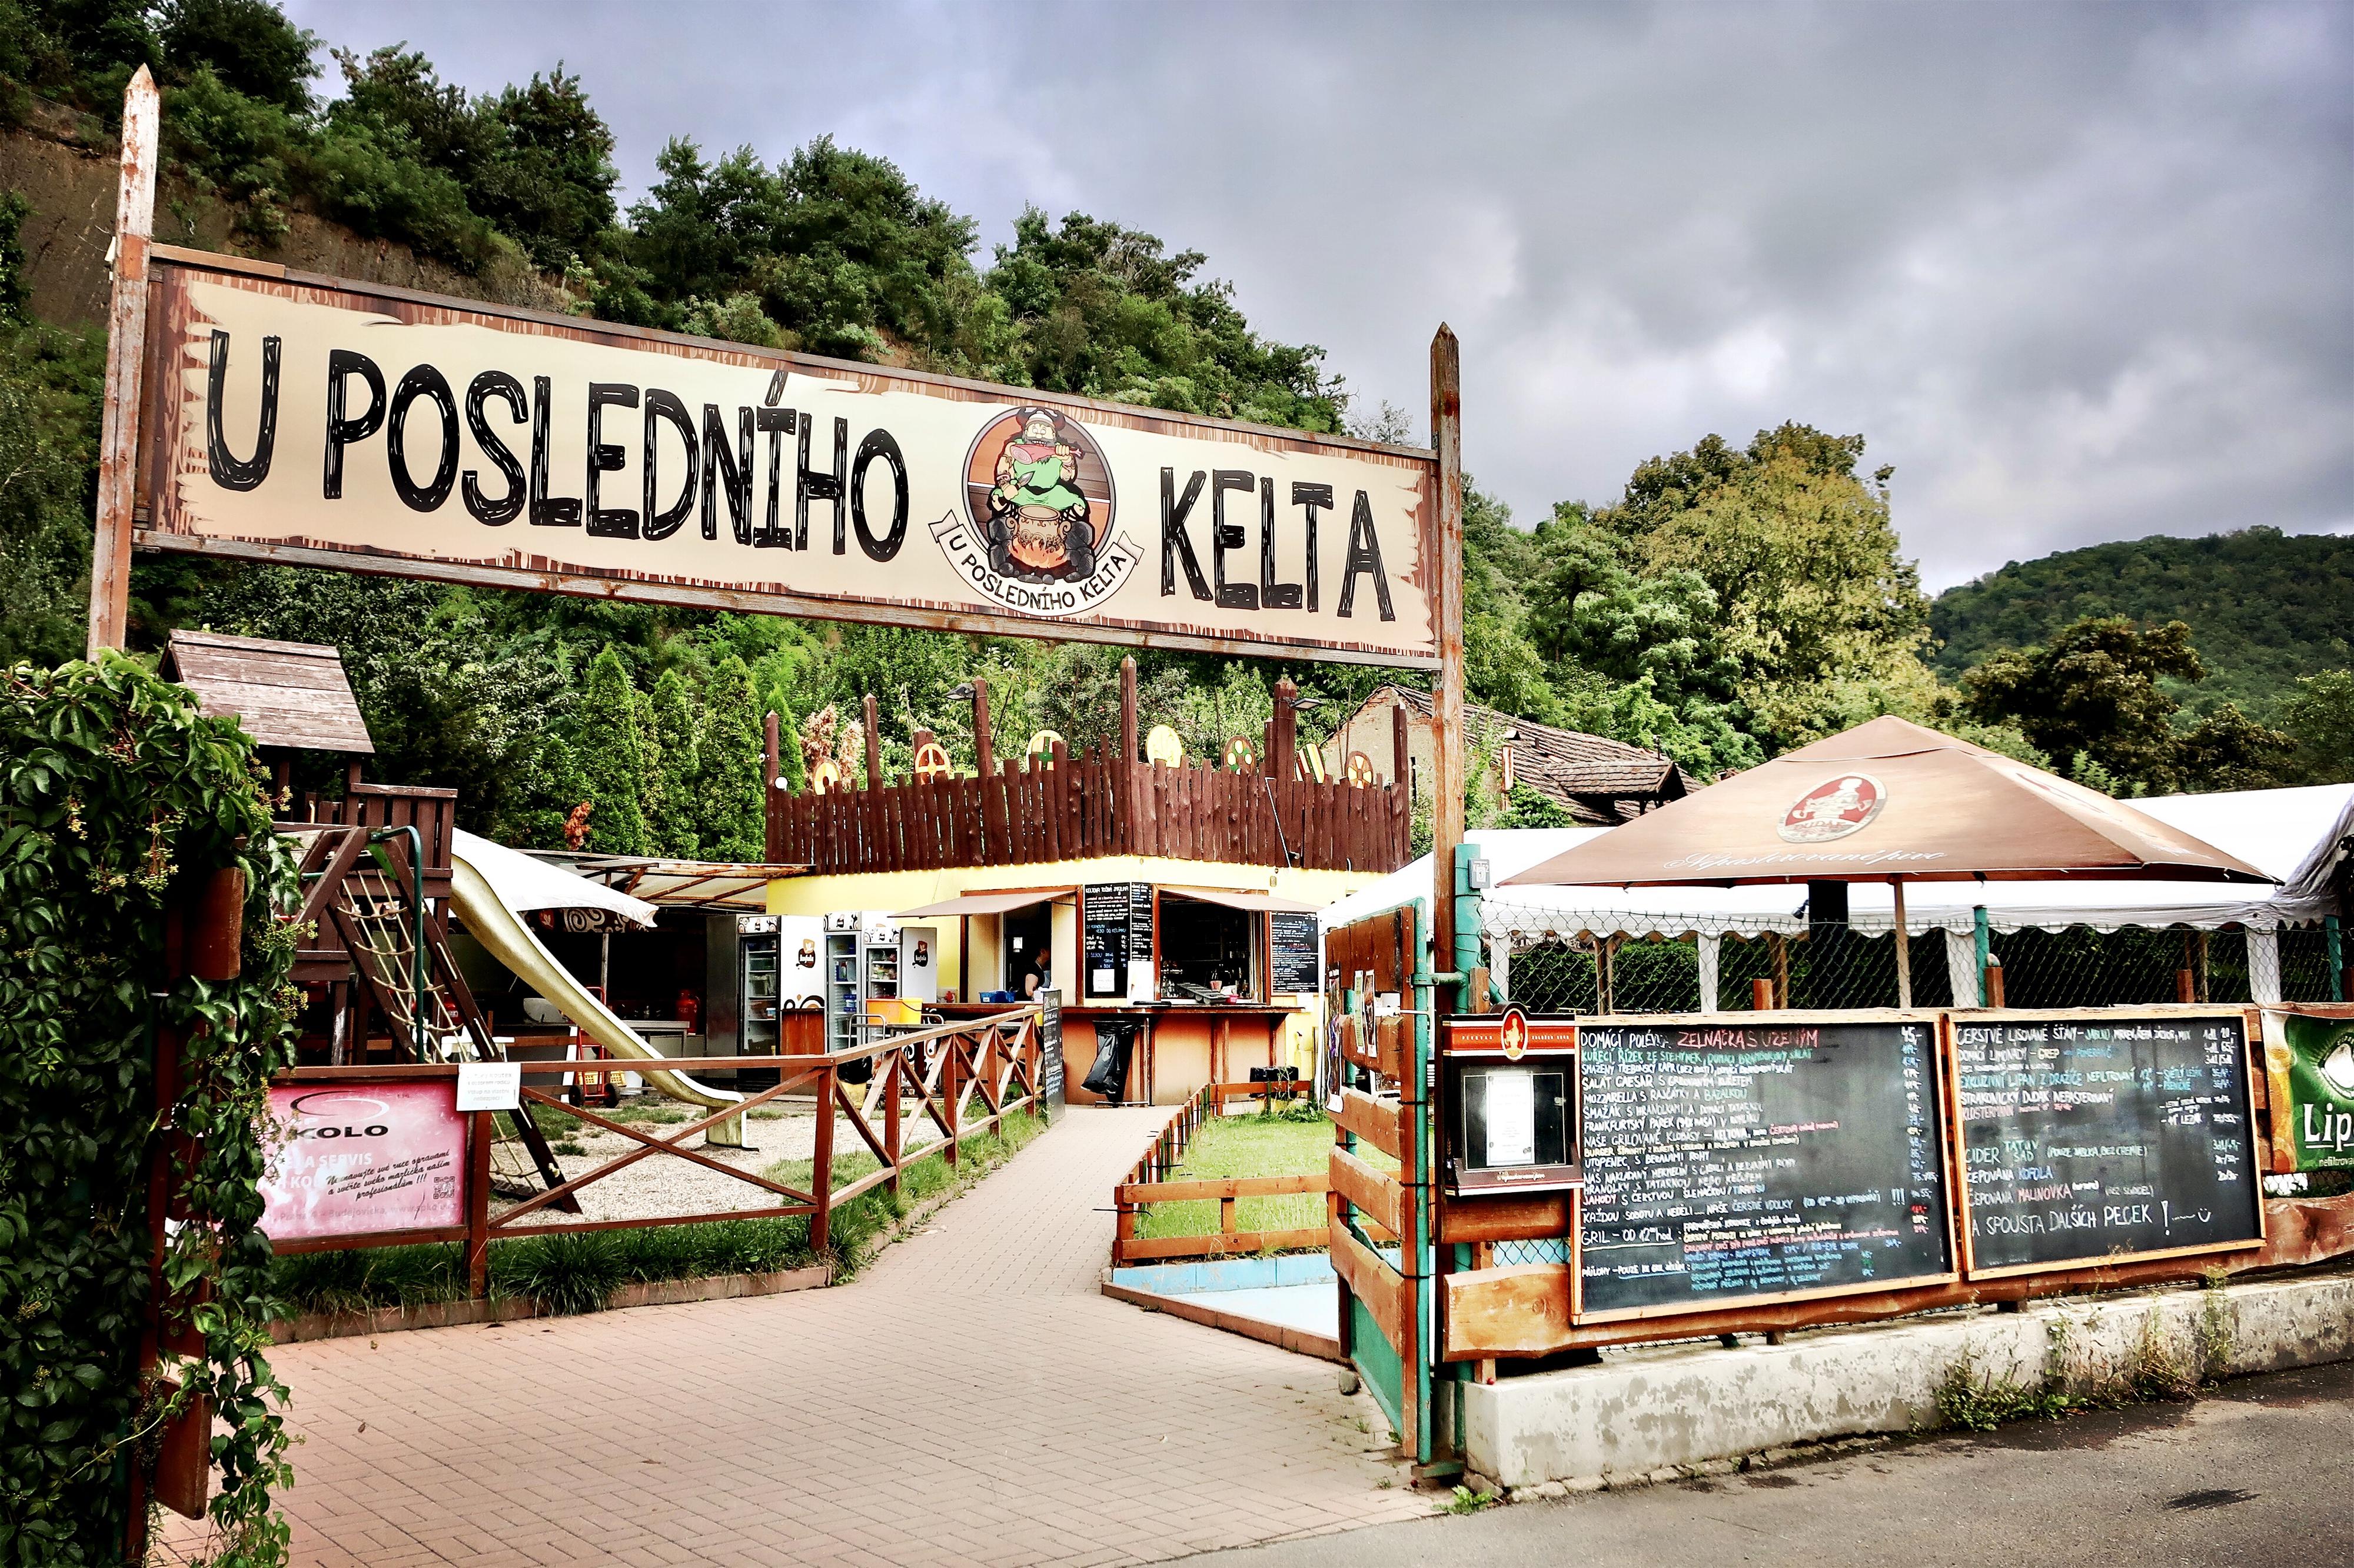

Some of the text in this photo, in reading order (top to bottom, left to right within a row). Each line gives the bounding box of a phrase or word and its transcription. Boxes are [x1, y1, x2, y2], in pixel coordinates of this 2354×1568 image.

[207, 329, 1395, 621] U POSLEDNÍHO KELTA
[949, 534, 1126, 610] U POSLEDNÍHO KELTA
[1865, 850, 1946, 865] pivo
[1581, 1029, 1624, 1049] DOMÁCÍ
[1618, 1048, 1644, 1063] ŘÍZEK
[1647, 1052, 1657, 1061] ZE
[1615, 1074, 1654, 1088] CAESAR
[1658, 1075, 1665, 1086] S
[1584, 1090, 1638, 1105] MOZZARELLA
[1639, 1090, 1647, 1101] S
[1694, 1089, 1700, 1100] A
[1627, 1106, 1633, 1116] S
[1688, 1105, 1695, 1116] A
[294, 1125, 388, 1139] KOLO
[1584, 1117, 1645, 1134] FRANKFURTSKÝ
[1720, 1117, 1727, 1127] V
[2303, 1103, 2354, 1151] Lip
[1584, 1132, 1607, 1147] NAŠE
[1612, 1130, 1661, 1146] GRILOVANÉ
[393, 1161, 409, 1169] ruce
[412, 1149, 450, 1167] opravami
[1584, 1146, 1615, 1157] BURGER
[1966, 1147, 2001, 1165] CIDER
[2013, 1150, 2034, 1163] SAD
[1635, 1156, 1641, 1164] S
[1691, 1166, 1697, 1174] S
[2018, 1166, 2054, 1181] KOFOLA
[1584, 1182, 1630, 1196] HRANOLKY
[1635, 1182, 1641, 1190] S
[2017, 1183, 2073, 1203] MALINOVKA
[1582, 1194, 1617, 1206] JAHODY
[1621, 1195, 1628, 1206] S
[1631, 1189, 1674, 1203] ČERSTVOU
[1583, 1207, 1619, 1223] KAŽDOU
[1656, 1209, 1663, 1218] A
[1973, 1219, 1980, 1237] A
[1986, 1214, 2046, 1236] SPOUSTA
[2049, 1204, 2097, 1231] DALŠÍCH
[2104, 1204, 2153, 1227] PECEK
[1582, 1231, 1610, 1246] GRIL
[1622, 1229, 1635, 1241] OD
